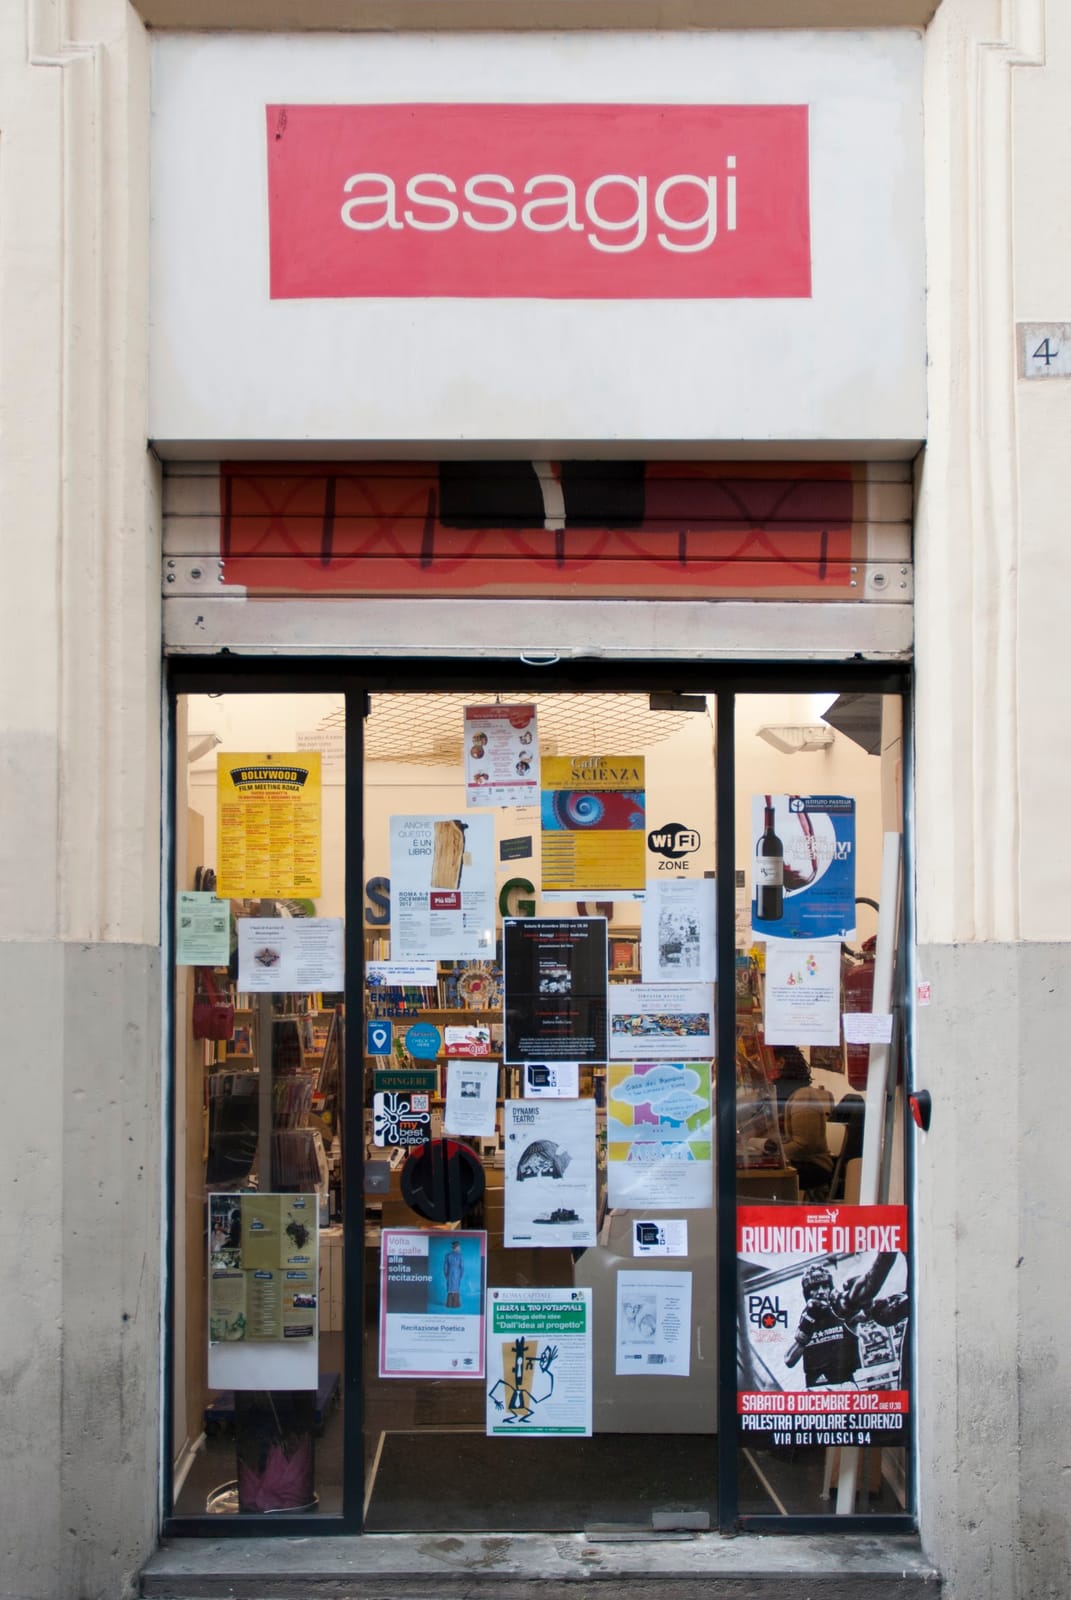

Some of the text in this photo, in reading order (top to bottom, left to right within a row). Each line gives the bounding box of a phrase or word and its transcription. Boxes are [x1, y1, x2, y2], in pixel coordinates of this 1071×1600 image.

[340, 155, 737, 253] assaggi
[1032, 337, 1059, 366] 4
[241, 770, 298, 781] BOLLYWOOD
[571, 768, 639, 780] SCIENZA
[403, 821, 432, 829] ANCHE
[398, 830, 432, 838] QUESTO
[420, 839, 432, 847] UN
[408, 848, 432, 856] LIBRO
[658, 860, 690, 870] ZONE
[371, 992, 424, 1003] ENTRATA
[375, 1007, 419, 1018] LIBERA
[512, 1107, 540, 1115] DYNAMIS
[512, 1115, 535, 1123] TEATRO
[399, 1122, 418, 1130] my
[400, 1128, 424, 1136] best
[400, 1136, 430, 1145] place
[389, 1237, 411, 1245] Volta
[741, 1225, 901, 1253] RIUNIONE DI BOXE
[388, 1274, 433, 1282] recitazione
[749, 1295, 784, 1314] PAL
[401, 1324, 439, 1332] Recitazione
[742, 1395, 785, 1411] SABATO
[787, 1395, 795, 1410] 8
[798, 1394, 851, 1411] DICEMBRE
[852, 1394, 879, 1410] 2012
[742, 1413, 903, 1430] PALESTRA POPOLARE S.LORENZO
[774, 1431, 871, 1444] VIA DEI VOLSCI 94
